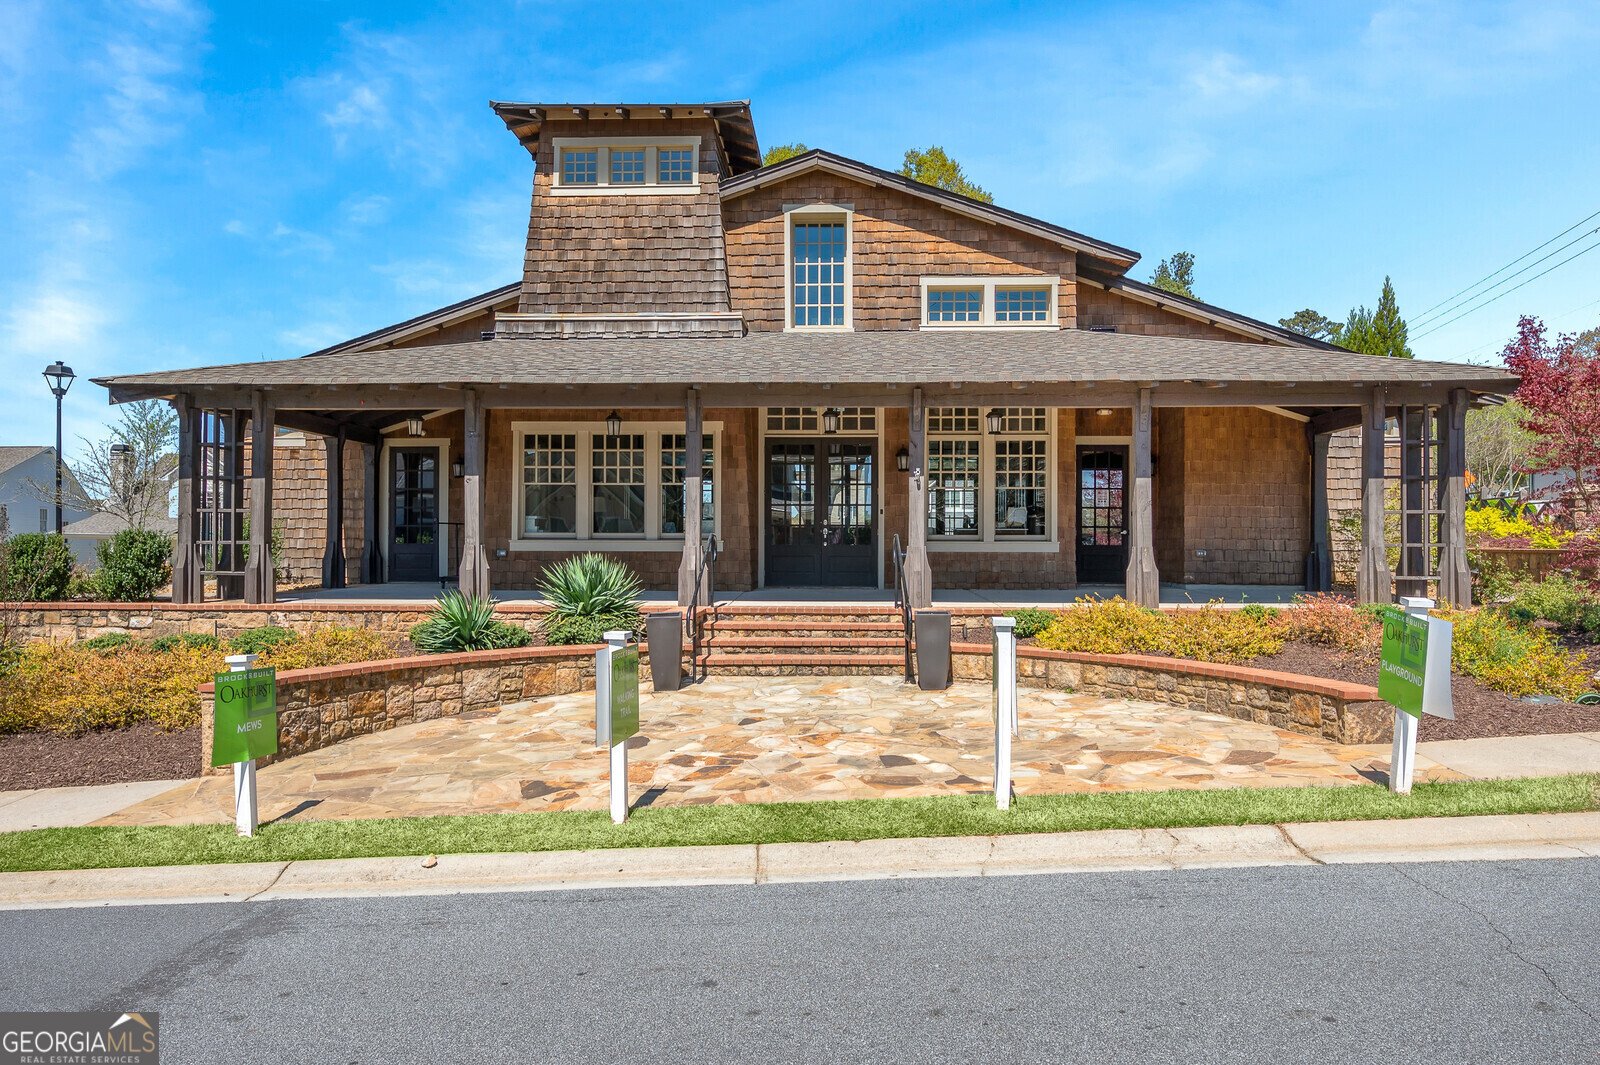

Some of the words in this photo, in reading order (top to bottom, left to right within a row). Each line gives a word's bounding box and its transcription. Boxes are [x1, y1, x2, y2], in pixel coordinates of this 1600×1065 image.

[1386, 622, 1424, 651] OAKHURST
[1382, 660, 1423, 686] PLAYGROUND
[220, 683, 272, 704] OAKHURST
[237, 720, 262, 734] MEWS
